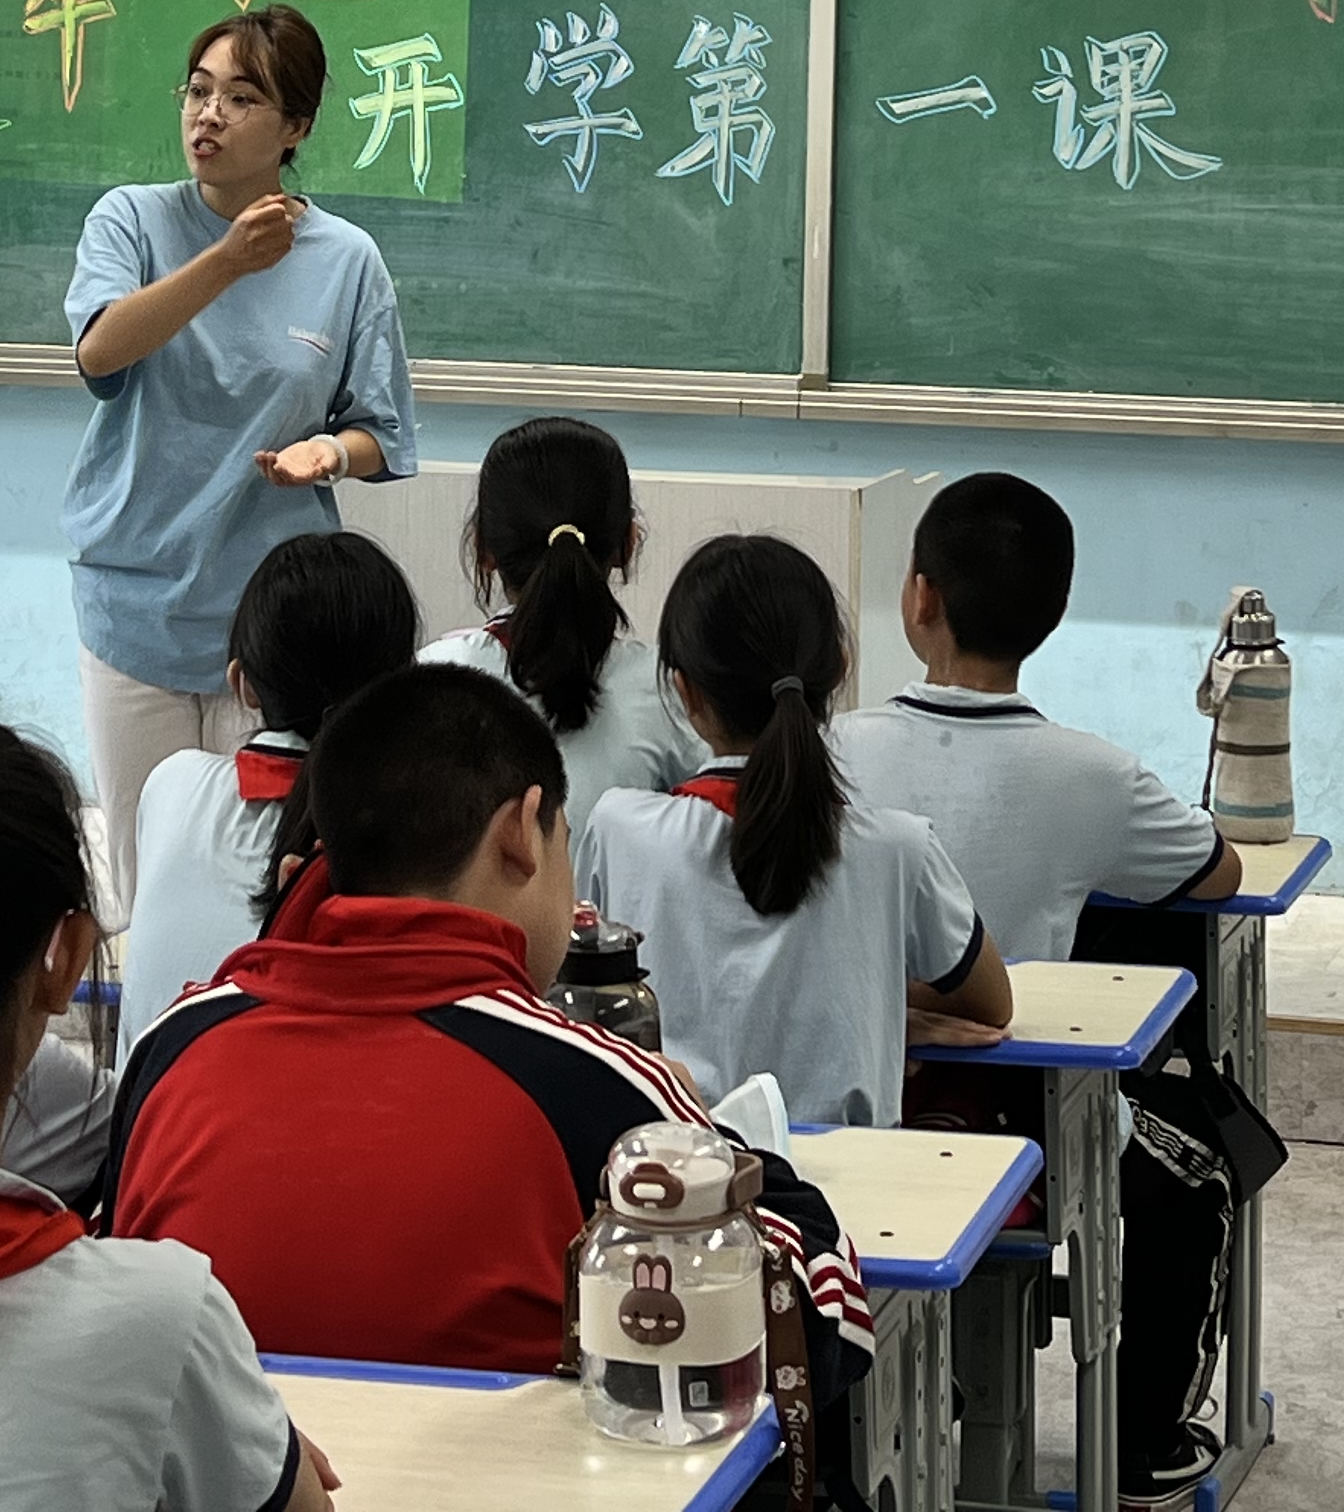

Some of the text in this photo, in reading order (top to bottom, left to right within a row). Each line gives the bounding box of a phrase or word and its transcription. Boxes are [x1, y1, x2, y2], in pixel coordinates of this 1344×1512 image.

[348, 1, 1222, 205] 开学第一课
